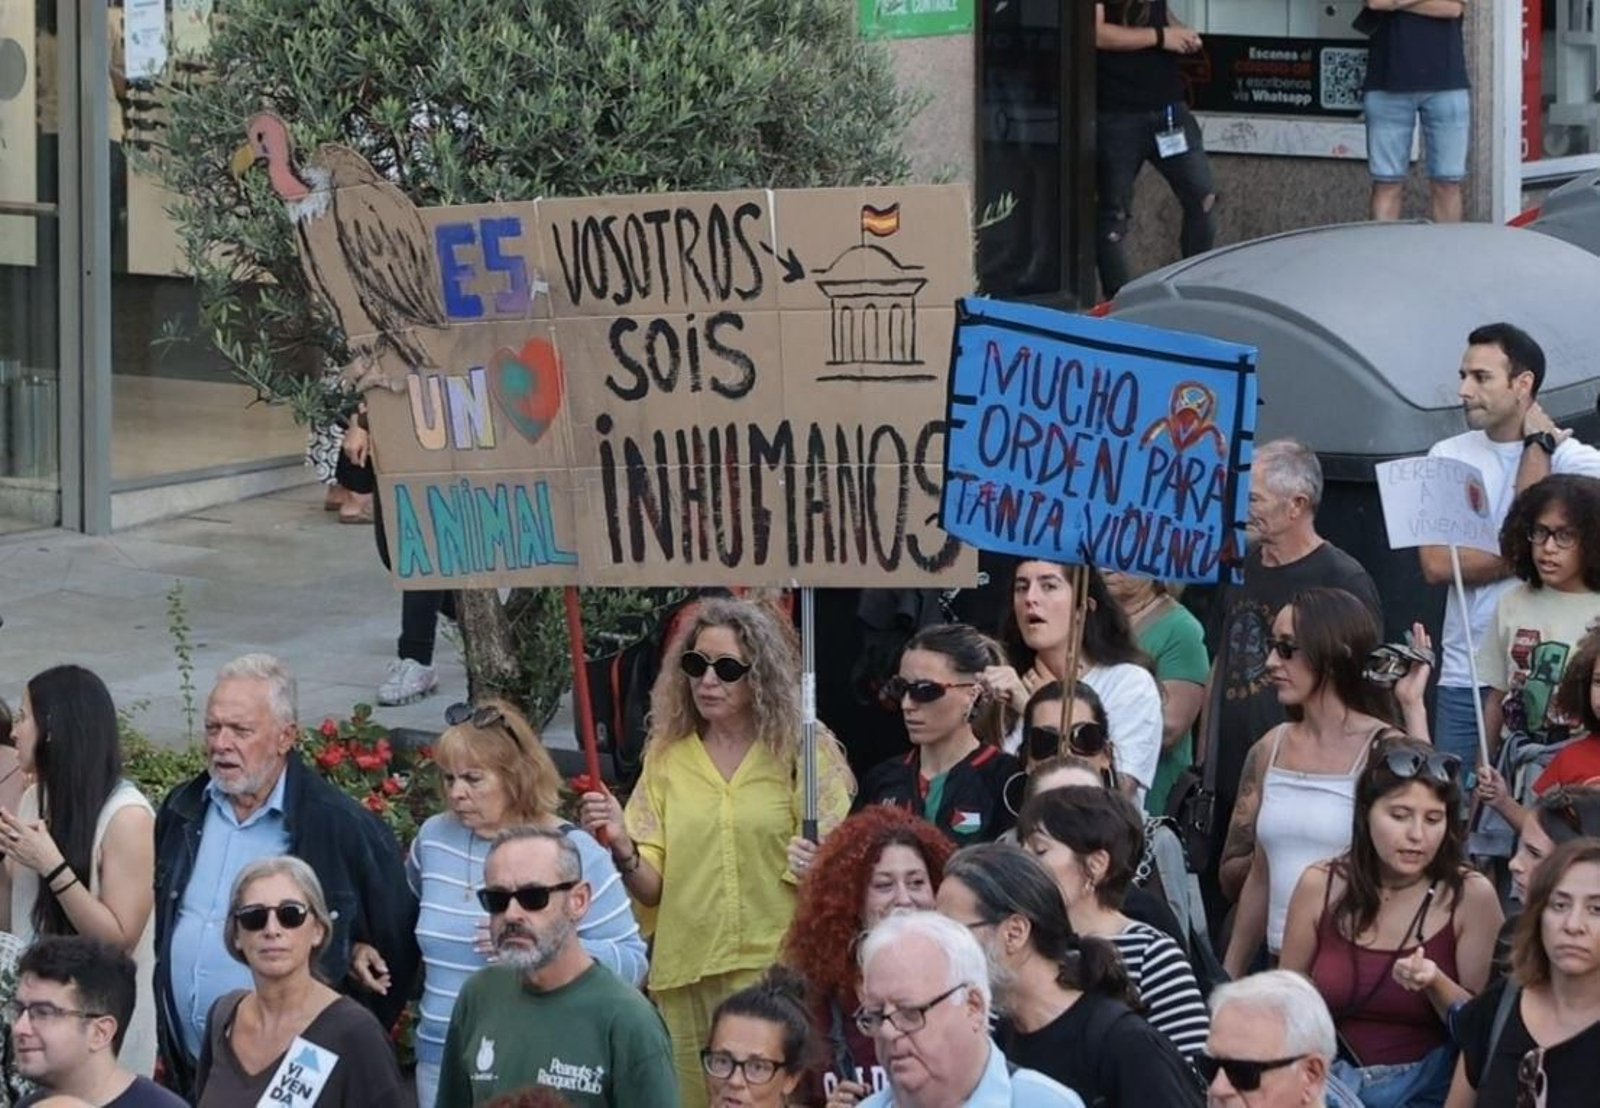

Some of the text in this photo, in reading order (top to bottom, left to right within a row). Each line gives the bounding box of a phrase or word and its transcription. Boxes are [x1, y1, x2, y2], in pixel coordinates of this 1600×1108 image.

[1249, 47, 1298, 60] Escanea
[1251, 90, 1312, 106] Whatsapp
[552, 202, 764, 305] VOSOTROS
[435, 216, 533, 319] ES
[980, 340, 1139, 438] MUCHO
[407, 367, 496, 450] UN
[979, 403, 1240, 523] ORDEN PARA
[1420, 481, 1434, 504] A
[947, 470, 1062, 551] TANTA
[288, 1062, 304, 1078] VI
[550, 1057, 592, 1079] Peanuts
[281, 1075, 313, 1099] VEN
[537, 1068, 602, 1095] Racquet Club
[269, 1087, 293, 1105] DA
